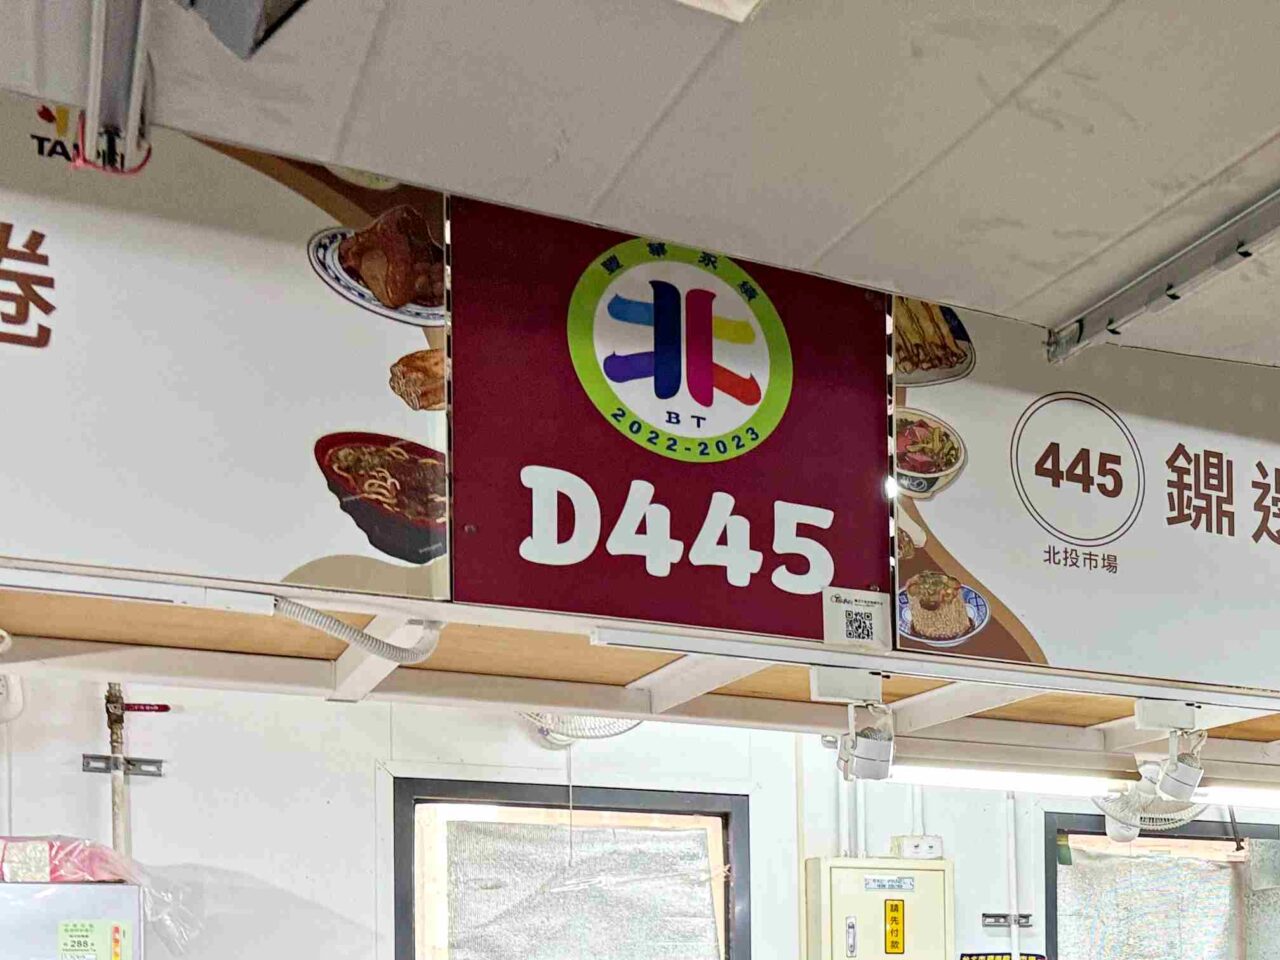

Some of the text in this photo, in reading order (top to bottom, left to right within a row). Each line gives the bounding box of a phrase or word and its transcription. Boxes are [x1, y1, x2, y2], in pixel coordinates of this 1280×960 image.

[611, 407, 760, 456] 2022-2023
[665, 411, 706, 428] BT
[1034, 441, 1123, 498] 445
[519, 465, 835, 595] D445
[1043, 545, 1118, 574] 北投市場
[889, 903, 900, 950] 請先付款
